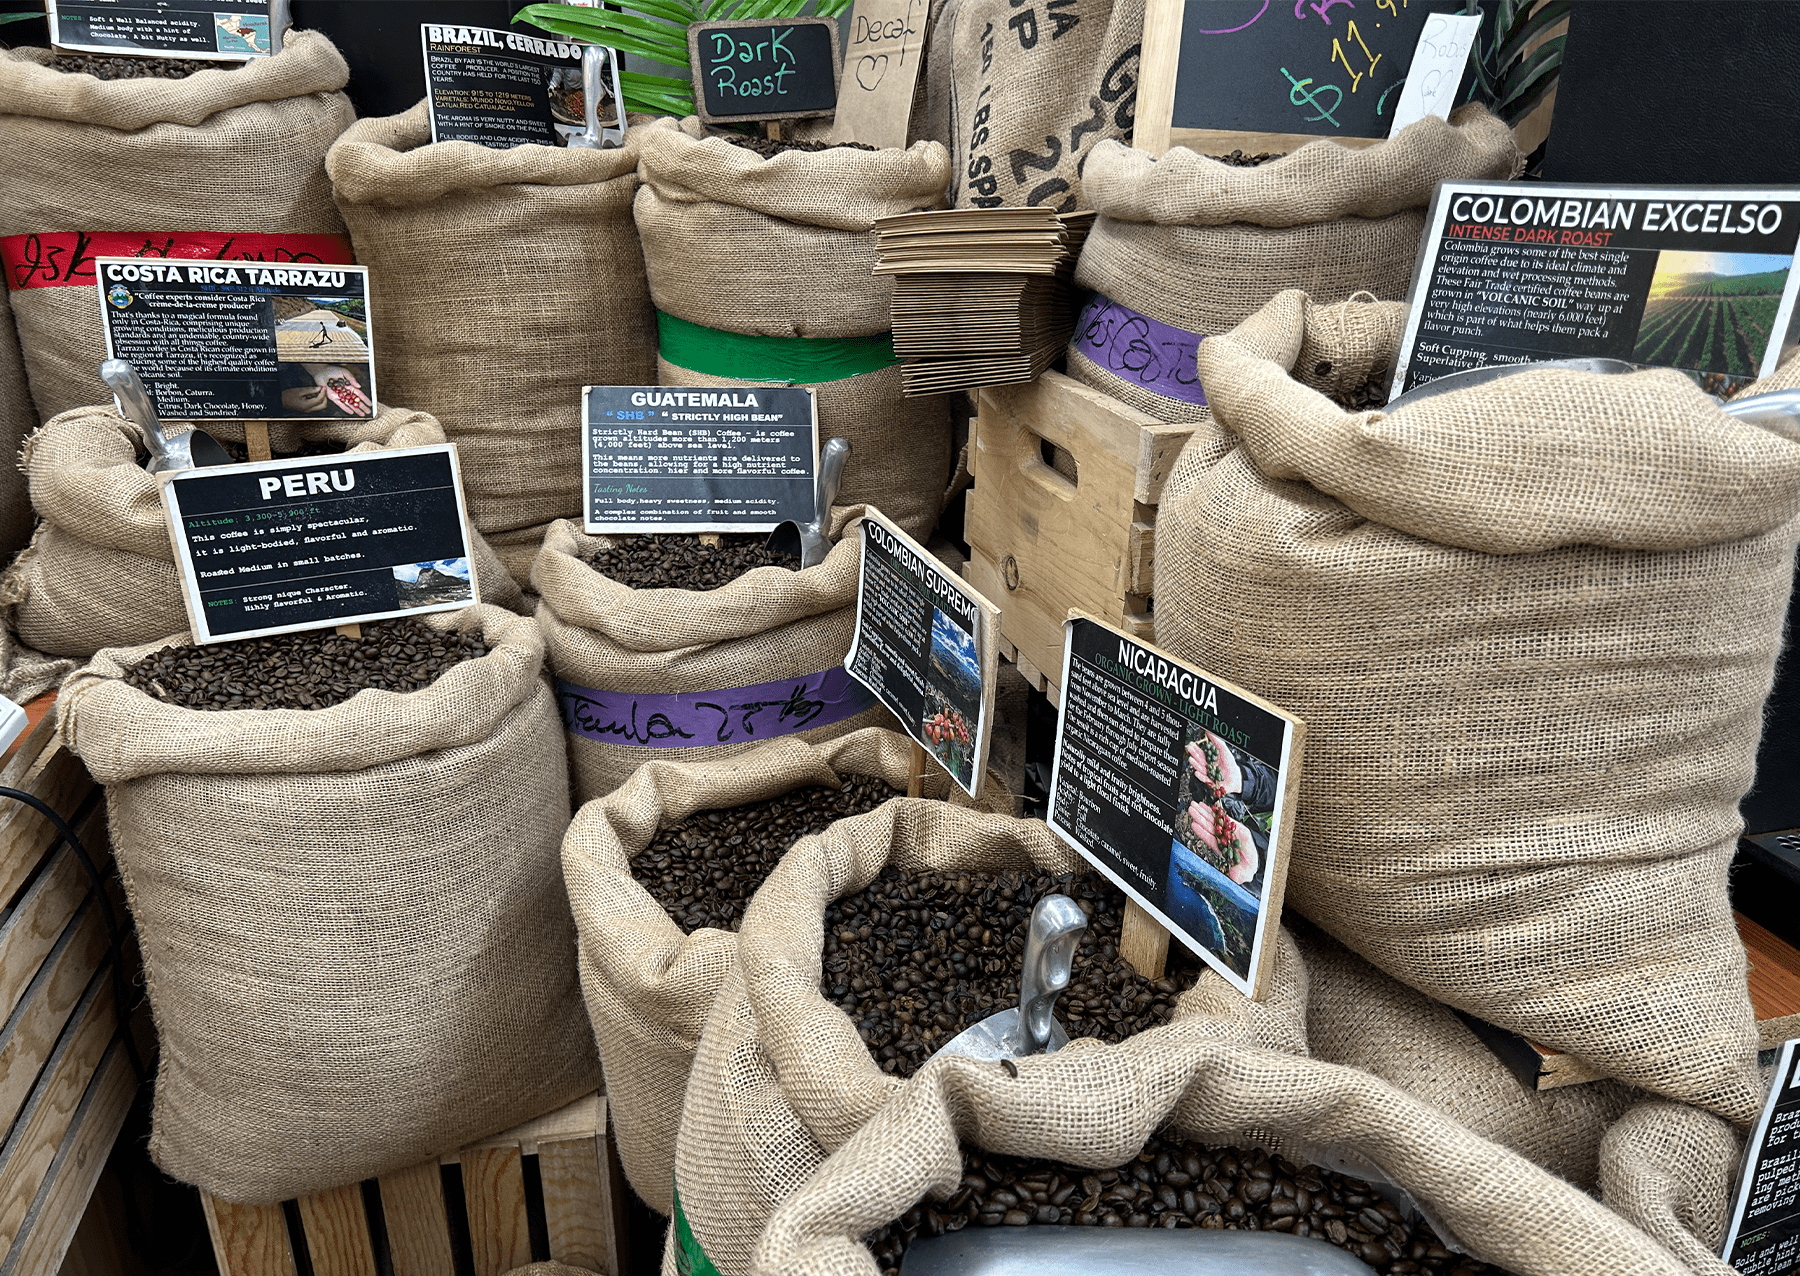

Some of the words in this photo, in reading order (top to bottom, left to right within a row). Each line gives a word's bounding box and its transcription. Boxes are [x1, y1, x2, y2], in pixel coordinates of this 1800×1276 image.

[429, 27, 504, 50] BRAZIL,
[506, 34, 582, 60] CERRADO
[853, 0, 922, 66] Decaf
[430, 43, 482, 54] RAINFOREST
[710, 62, 796, 97] Roast
[1451, 196, 1638, 231] COLOMBIAN
[1641, 203, 1783, 235] EXCELSO
[1448, 224, 1510, 241] INTENSE
[1513, 227, 1557, 244] DARK
[1560, 230, 1614, 247] ROAST
[1440, 253, 1469, 265] origin
[1469, 254, 1498, 265] coffee
[1499, 256, 1518, 267] due
[1520, 259, 1530, 268] to
[1531, 258, 1543, 269] its
[1545, 259, 1569, 271] ideal
[1570, 261, 1606, 273] climate
[1607, 264, 1627, 275] and
[1444, 240, 1488, 253] Colombia
[1489, 246, 1519, 256] grows
[1521, 248, 1547, 257] some
[1548, 247, 1560, 258] of
[1560, 248, 1576, 259] the
[1578, 248, 1598, 260] best
[1599, 250, 1629, 264] single
[107, 264, 184, 284] COSTA
[188, 266, 242, 286] RICA
[244, 268, 346, 288] TARRAZU
[1437, 263, 1480, 276] elevation
[1481, 267, 1500, 278] and
[1502, 271, 1519, 280] wet
[1520, 272, 1572, 287] processing
[1573, 275, 1616, 287] methods.
[165, 293, 193, 302] experts
[193, 293, 226, 301] consider
[226, 294, 248, 302] Costa
[1436, 274, 1462, 286] These
[1463, 277, 1482, 288] Fair
[1484, 279, 1512, 291] Trade
[1512, 283, 1552, 294] certified
[1553, 284, 1582, 297] coffee
[1584, 287, 1612, 299] beans
[1613, 292, 1629, 301] are
[1431, 288, 1462, 298] grown
[1464, 289, 1473, 299] in
[1575, 302, 1596, 312] way
[1598, 304, 1612, 315] up
[1612, 304, 1623, 314] at
[1416, 352, 1473, 369] Superlative
[1418, 342, 1441, 353] Soft
[1441, 344, 1488, 361] Cupping,
[1492, 353, 1531, 364] smooth
[157, 402, 182, 410] Citrus,
[202, 402, 240, 410] Chocolate,
[241, 402, 267, 410] Honey.
[630, 391, 759, 407] GUATEMALA
[671, 412, 720, 421] STRICTLY
[722, 413, 748, 421] HIGH
[592, 428, 633, 436] Strictly
[622, 434, 668, 442] altitudes
[697, 435, 717, 443] than
[258, 468, 355, 500] PERU
[593, 483, 623, 495] Tasting
[625, 483, 648, 493] Notes
[191, 534, 215, 542] This
[219, 530, 248, 539] coffee
[269, 523, 302, 533] simply
[307, 516, 369, 530] spectacular,
[229, 538, 298, 553] light-bodied,
[303, 532, 347, 543] flavorful
[351, 529, 368, 537] and
[371, 524, 417, 535] aromatic.
[868, 522, 925, 582] COLOMBIAN
[199, 567, 235, 578] Roasted
[238, 564, 273, 573] Medium
[292, 556, 320, 566] small
[323, 552, 365, 562] batches.
[242, 594, 272, 603] Strong
[276, 590, 301, 598] nique
[304, 583, 352, 594] Character.
[244, 603, 269, 611] Hihly
[273, 596, 312, 607] flavorful
[325, 590, 367, 600] Aromatic.
[1118, 639, 1218, 716] NICARAGUA
[1095, 652, 1135, 683] ORGANIC
[1135, 675, 1173, 704] GROWN
[1179, 698, 1211, 727] LIGHT
[1212, 718, 1251, 749] ROAST
[1082, 763, 1103, 784] tropical
[1102, 778, 1119, 796] fruits
[1118, 792, 1131, 805] and
[1130, 799, 1142, 814] rich
[1143, 809, 1173, 835] chocolate
[1767, 1134, 1788, 1148] for
[1757, 1161, 1796, 1185] pulped
[1751, 1193, 1771, 1207] are
[1755, 1181, 1775, 1195] ing
[1747, 1194, 1796, 1219] removing
[1734, 1251, 1757, 1269] Bold
[1759, 1243, 1777, 1259] and
[1778, 1234, 1799, 1250] well
[1740, 1231, 1771, 1248] NOTES:
[1742, 1257, 1772, 1275] subtle
[1775, 1246, 1796, 1262] hint
[1767, 1261, 1792, 1275] clean
